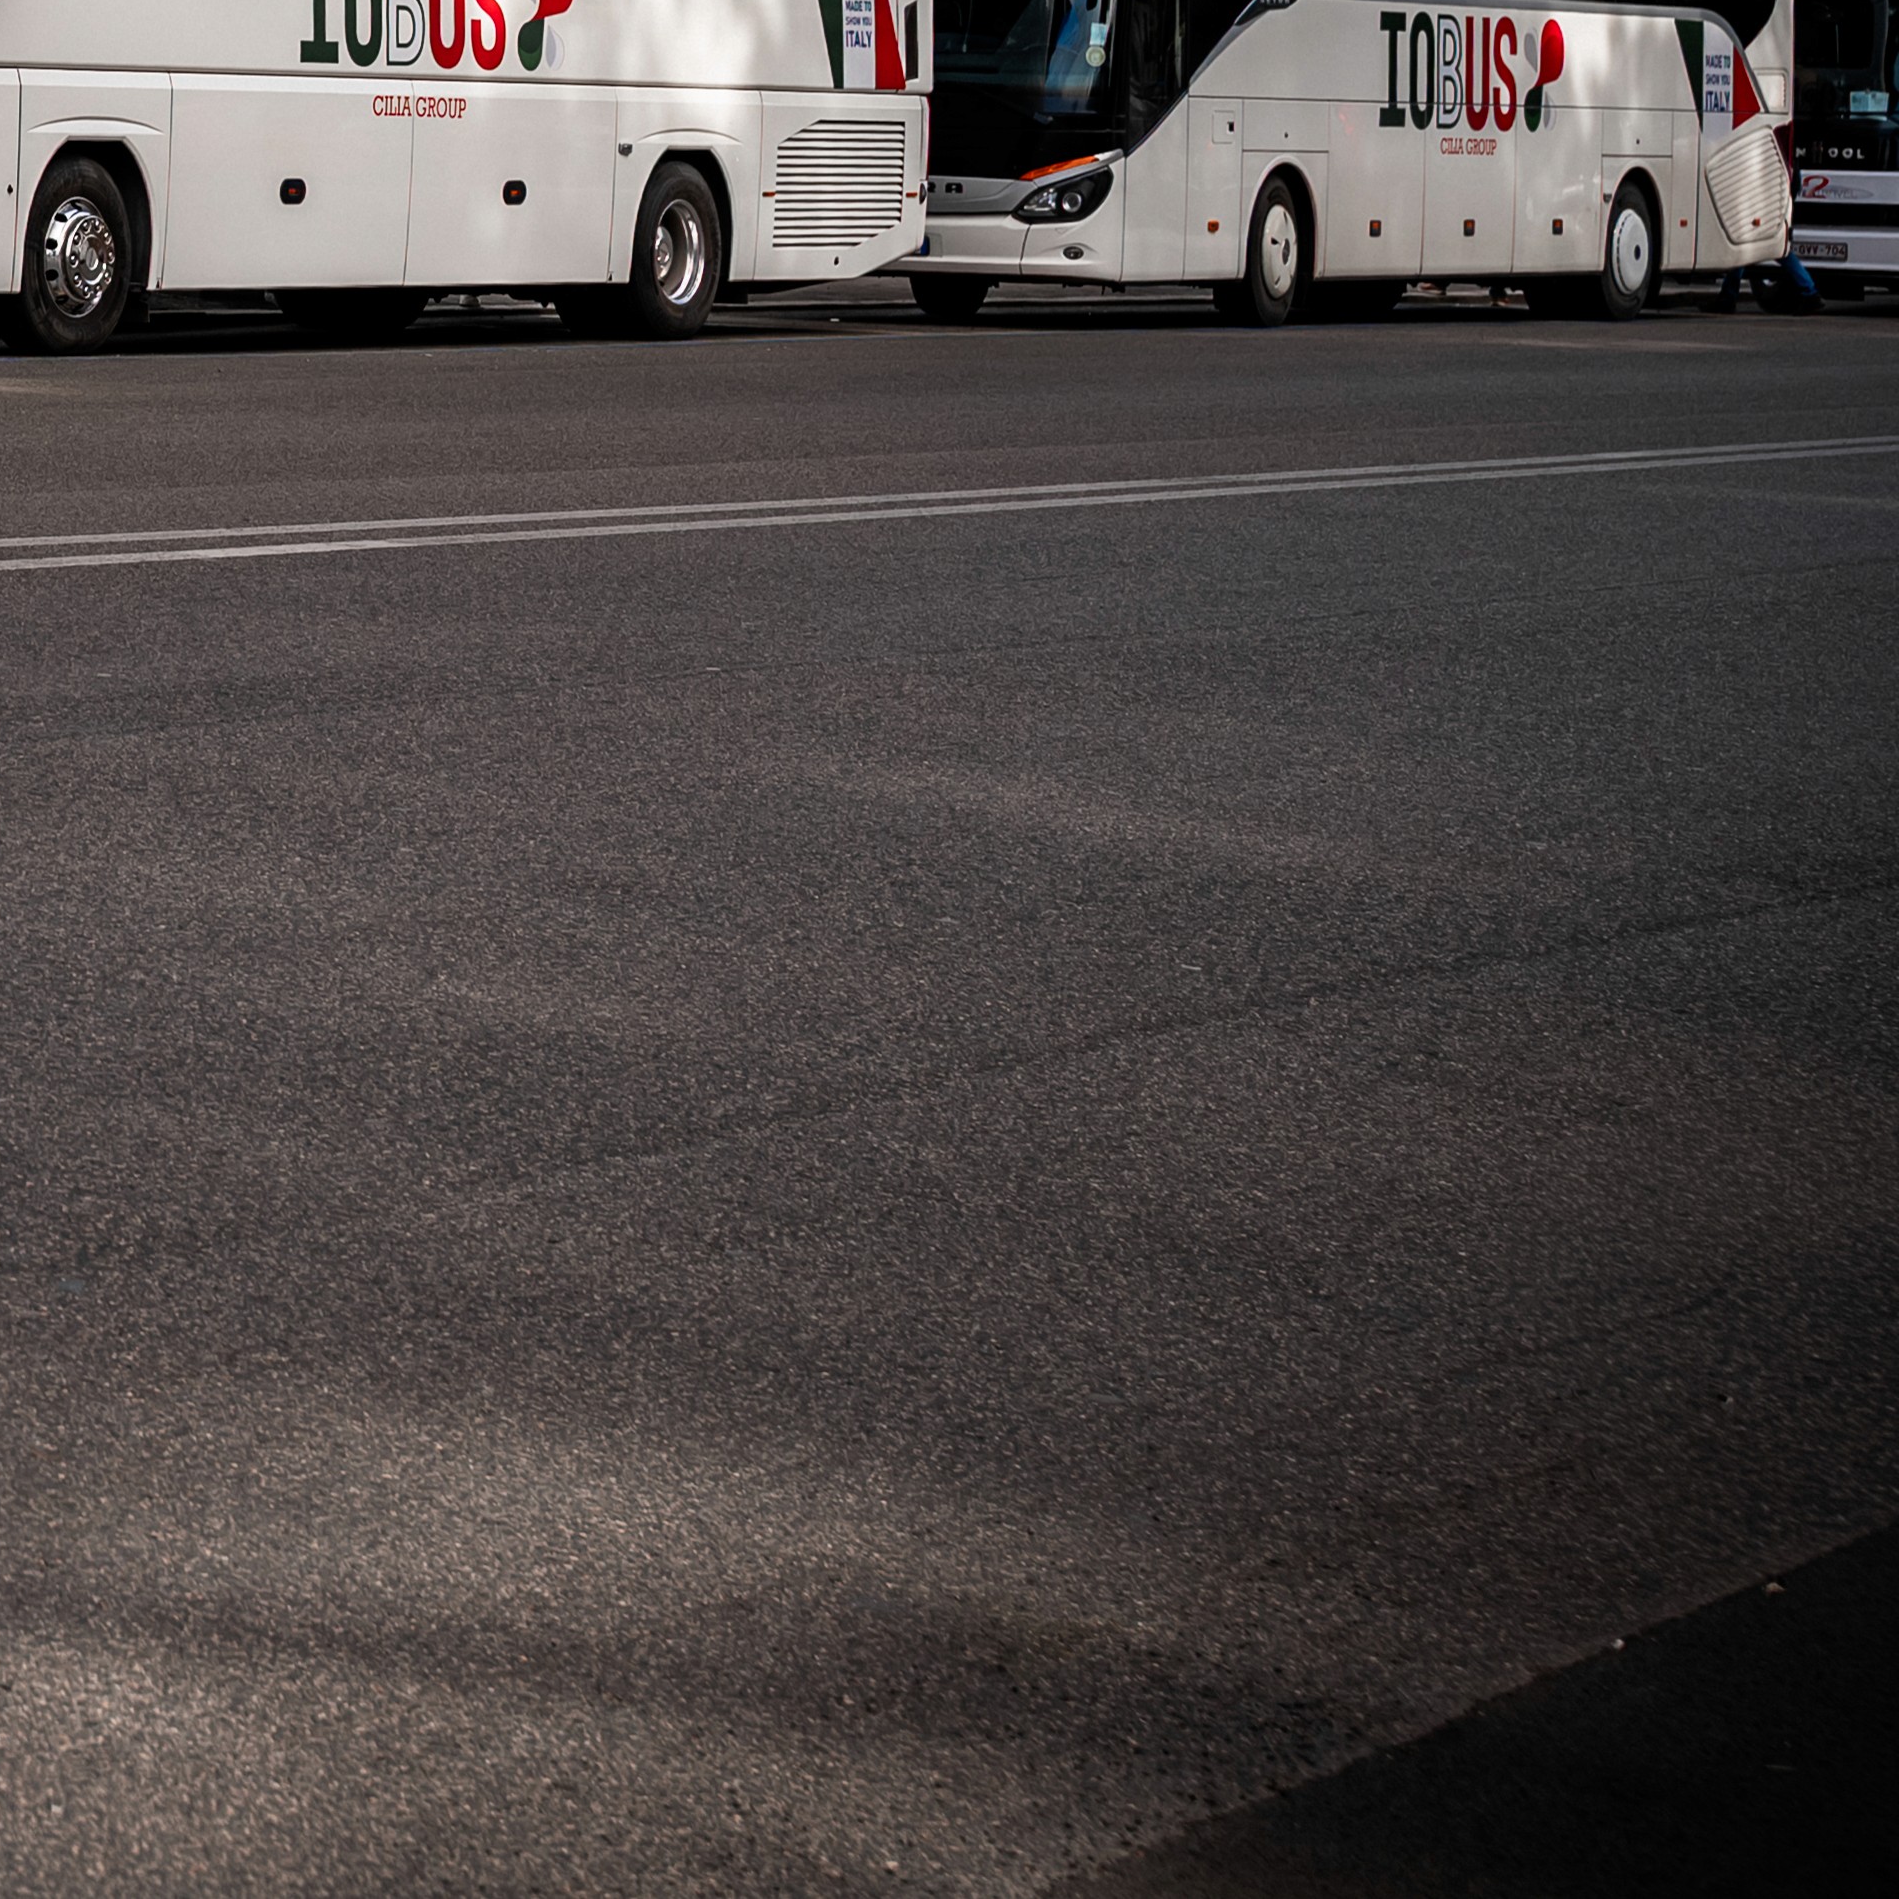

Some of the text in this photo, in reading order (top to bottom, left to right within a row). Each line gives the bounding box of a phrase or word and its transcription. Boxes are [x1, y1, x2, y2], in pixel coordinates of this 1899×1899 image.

[845, 0, 872, 12] MADE TO
[845, 30, 872, 48] ITALY
[1379, 11, 1517, 132] IOBUS
[373, 95, 467, 118] CILIA GROUP
[1705, 90, 1730, 112] ITALY
[1440, 137, 1497, 155] CILIA GROUP
